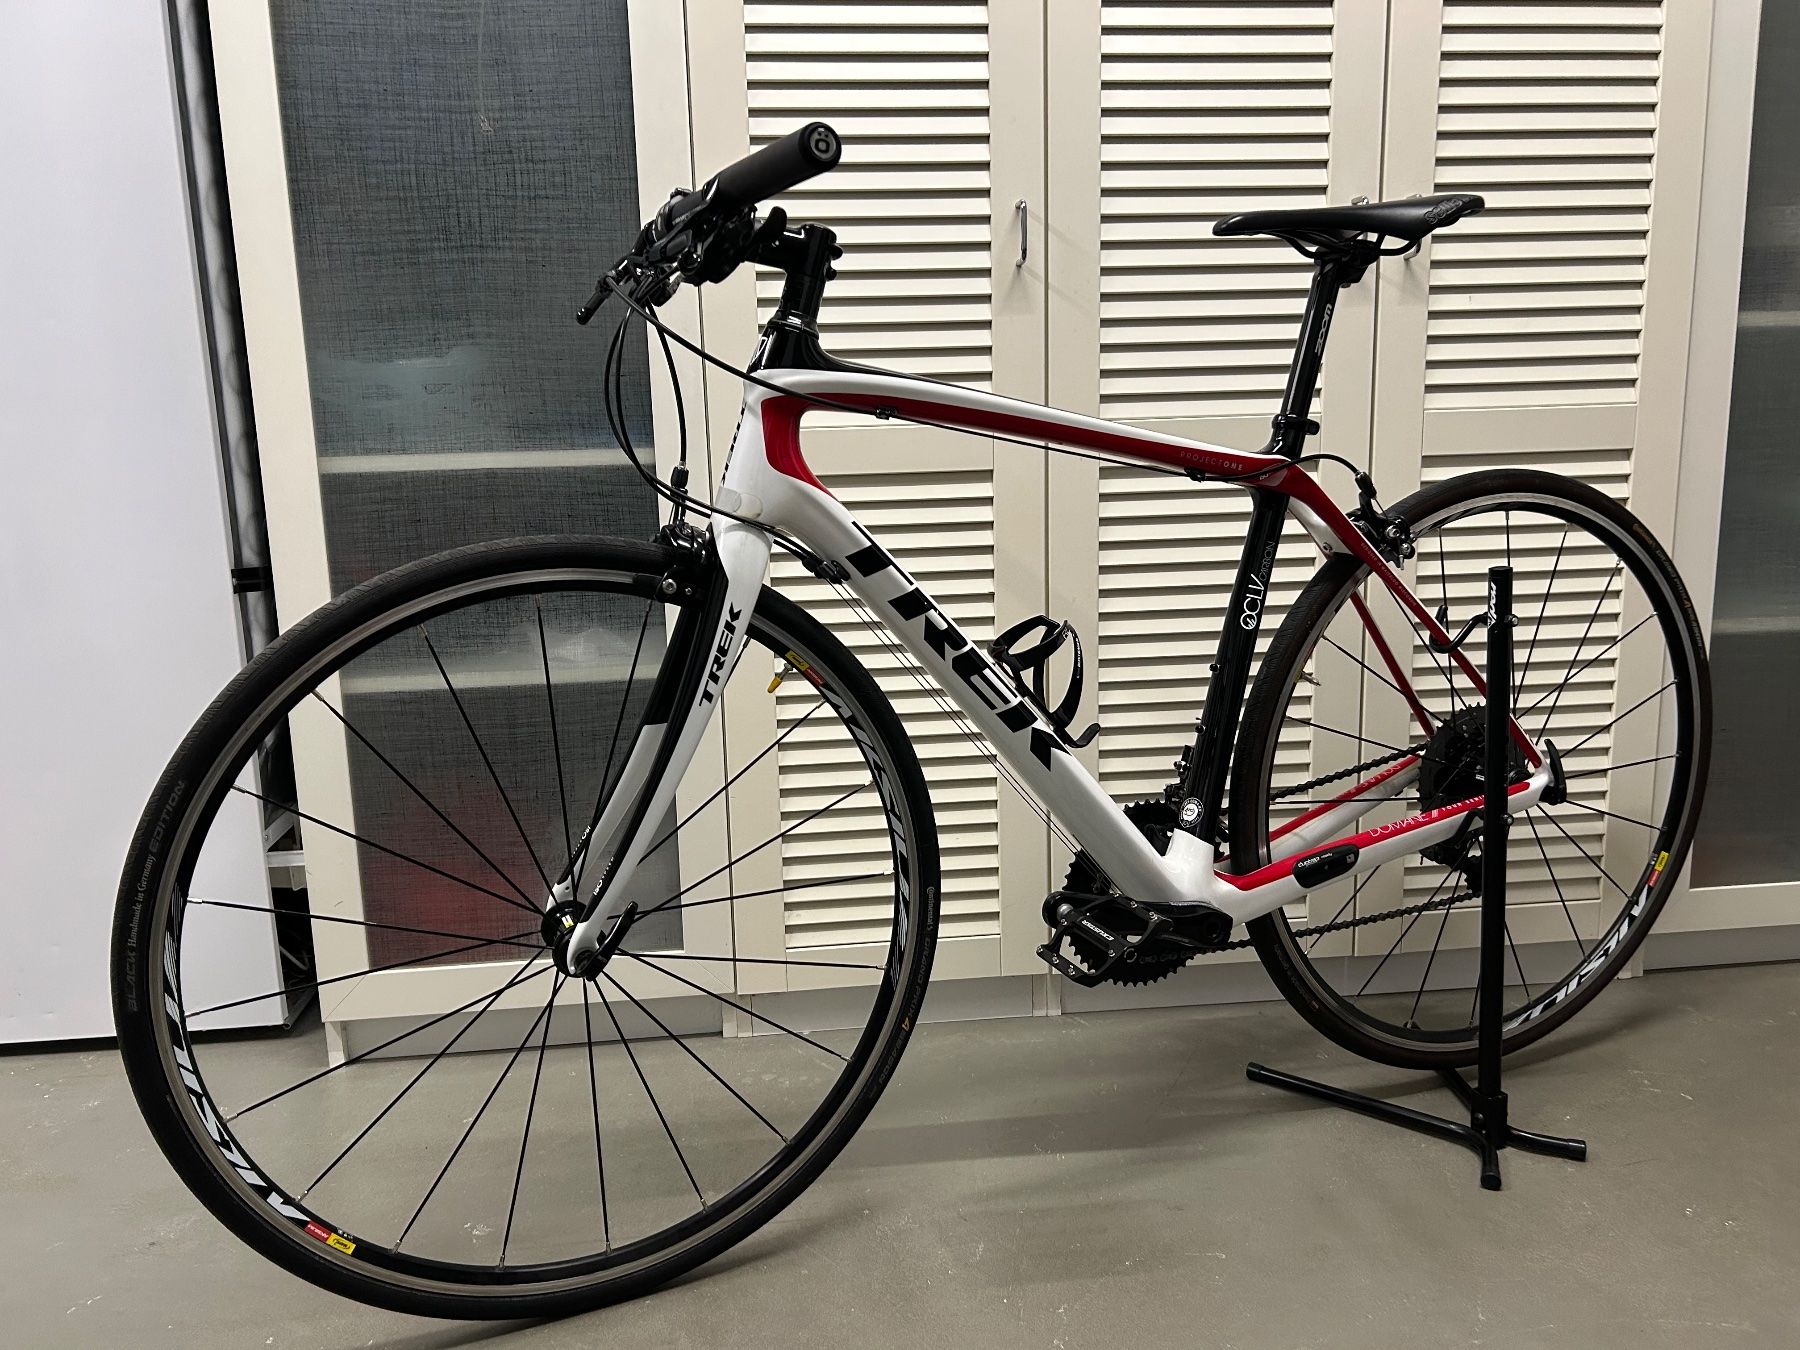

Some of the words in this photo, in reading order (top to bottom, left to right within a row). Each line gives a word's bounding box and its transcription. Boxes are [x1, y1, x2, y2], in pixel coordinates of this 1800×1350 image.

[699, 606, 742, 708] TREK
[845, 520, 1072, 771] TREK
[151, 780, 185, 852] EDITION
[1369, 814, 1430, 837] DOMANE
[138, 854, 156, 891] Germany
[138, 890, 145, 902] in
[127, 902, 144, 948] Handmade
[128, 952, 139, 1012] BLACK
